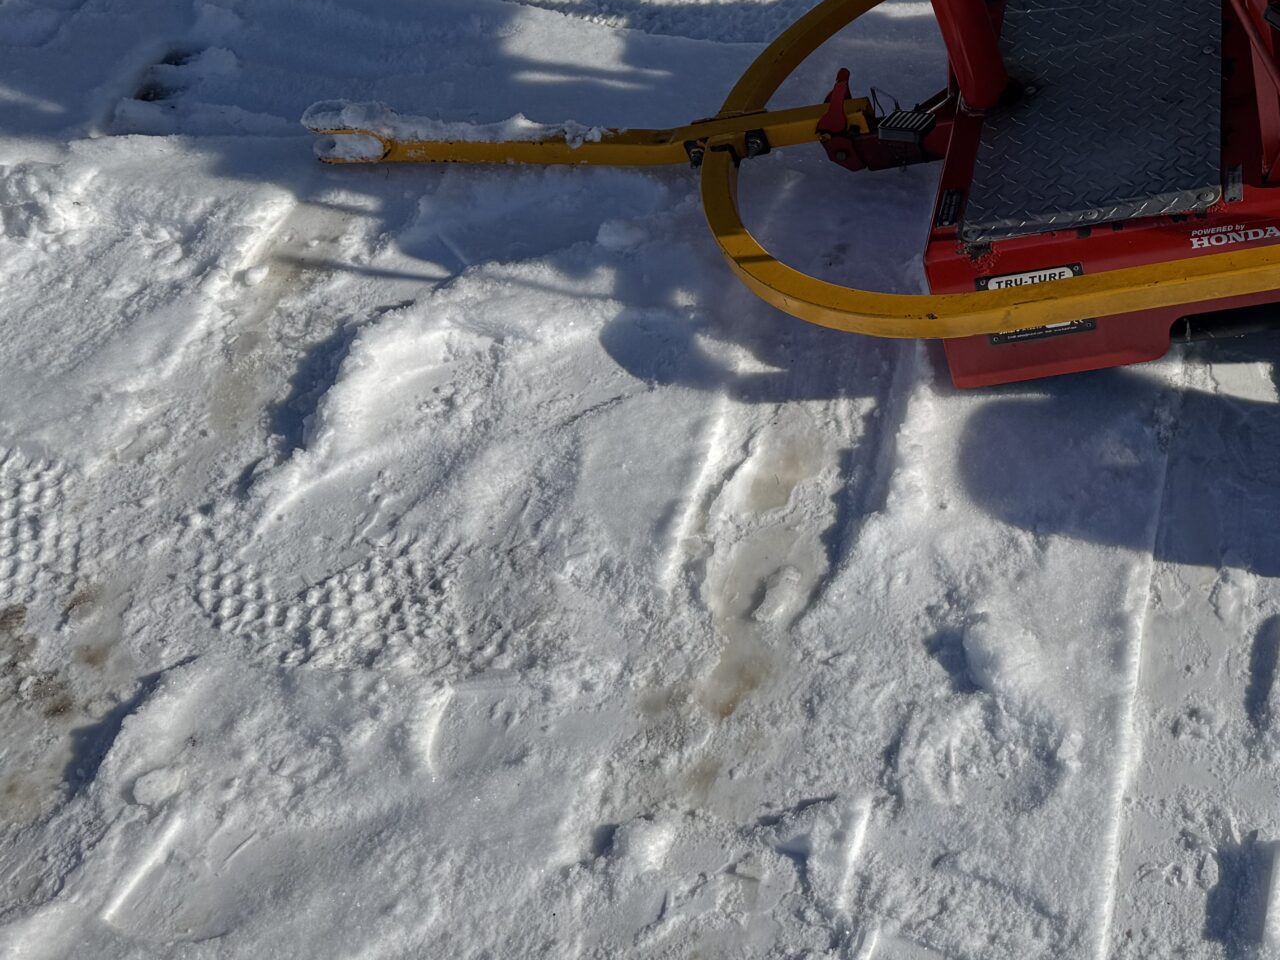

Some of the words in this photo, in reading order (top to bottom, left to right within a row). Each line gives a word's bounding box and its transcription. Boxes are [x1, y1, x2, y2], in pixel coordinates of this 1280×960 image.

[1191, 224, 1234, 237] POWERED
[1235, 223, 1245, 231] by
[995, 271, 1067, 289] TRU-TURF
